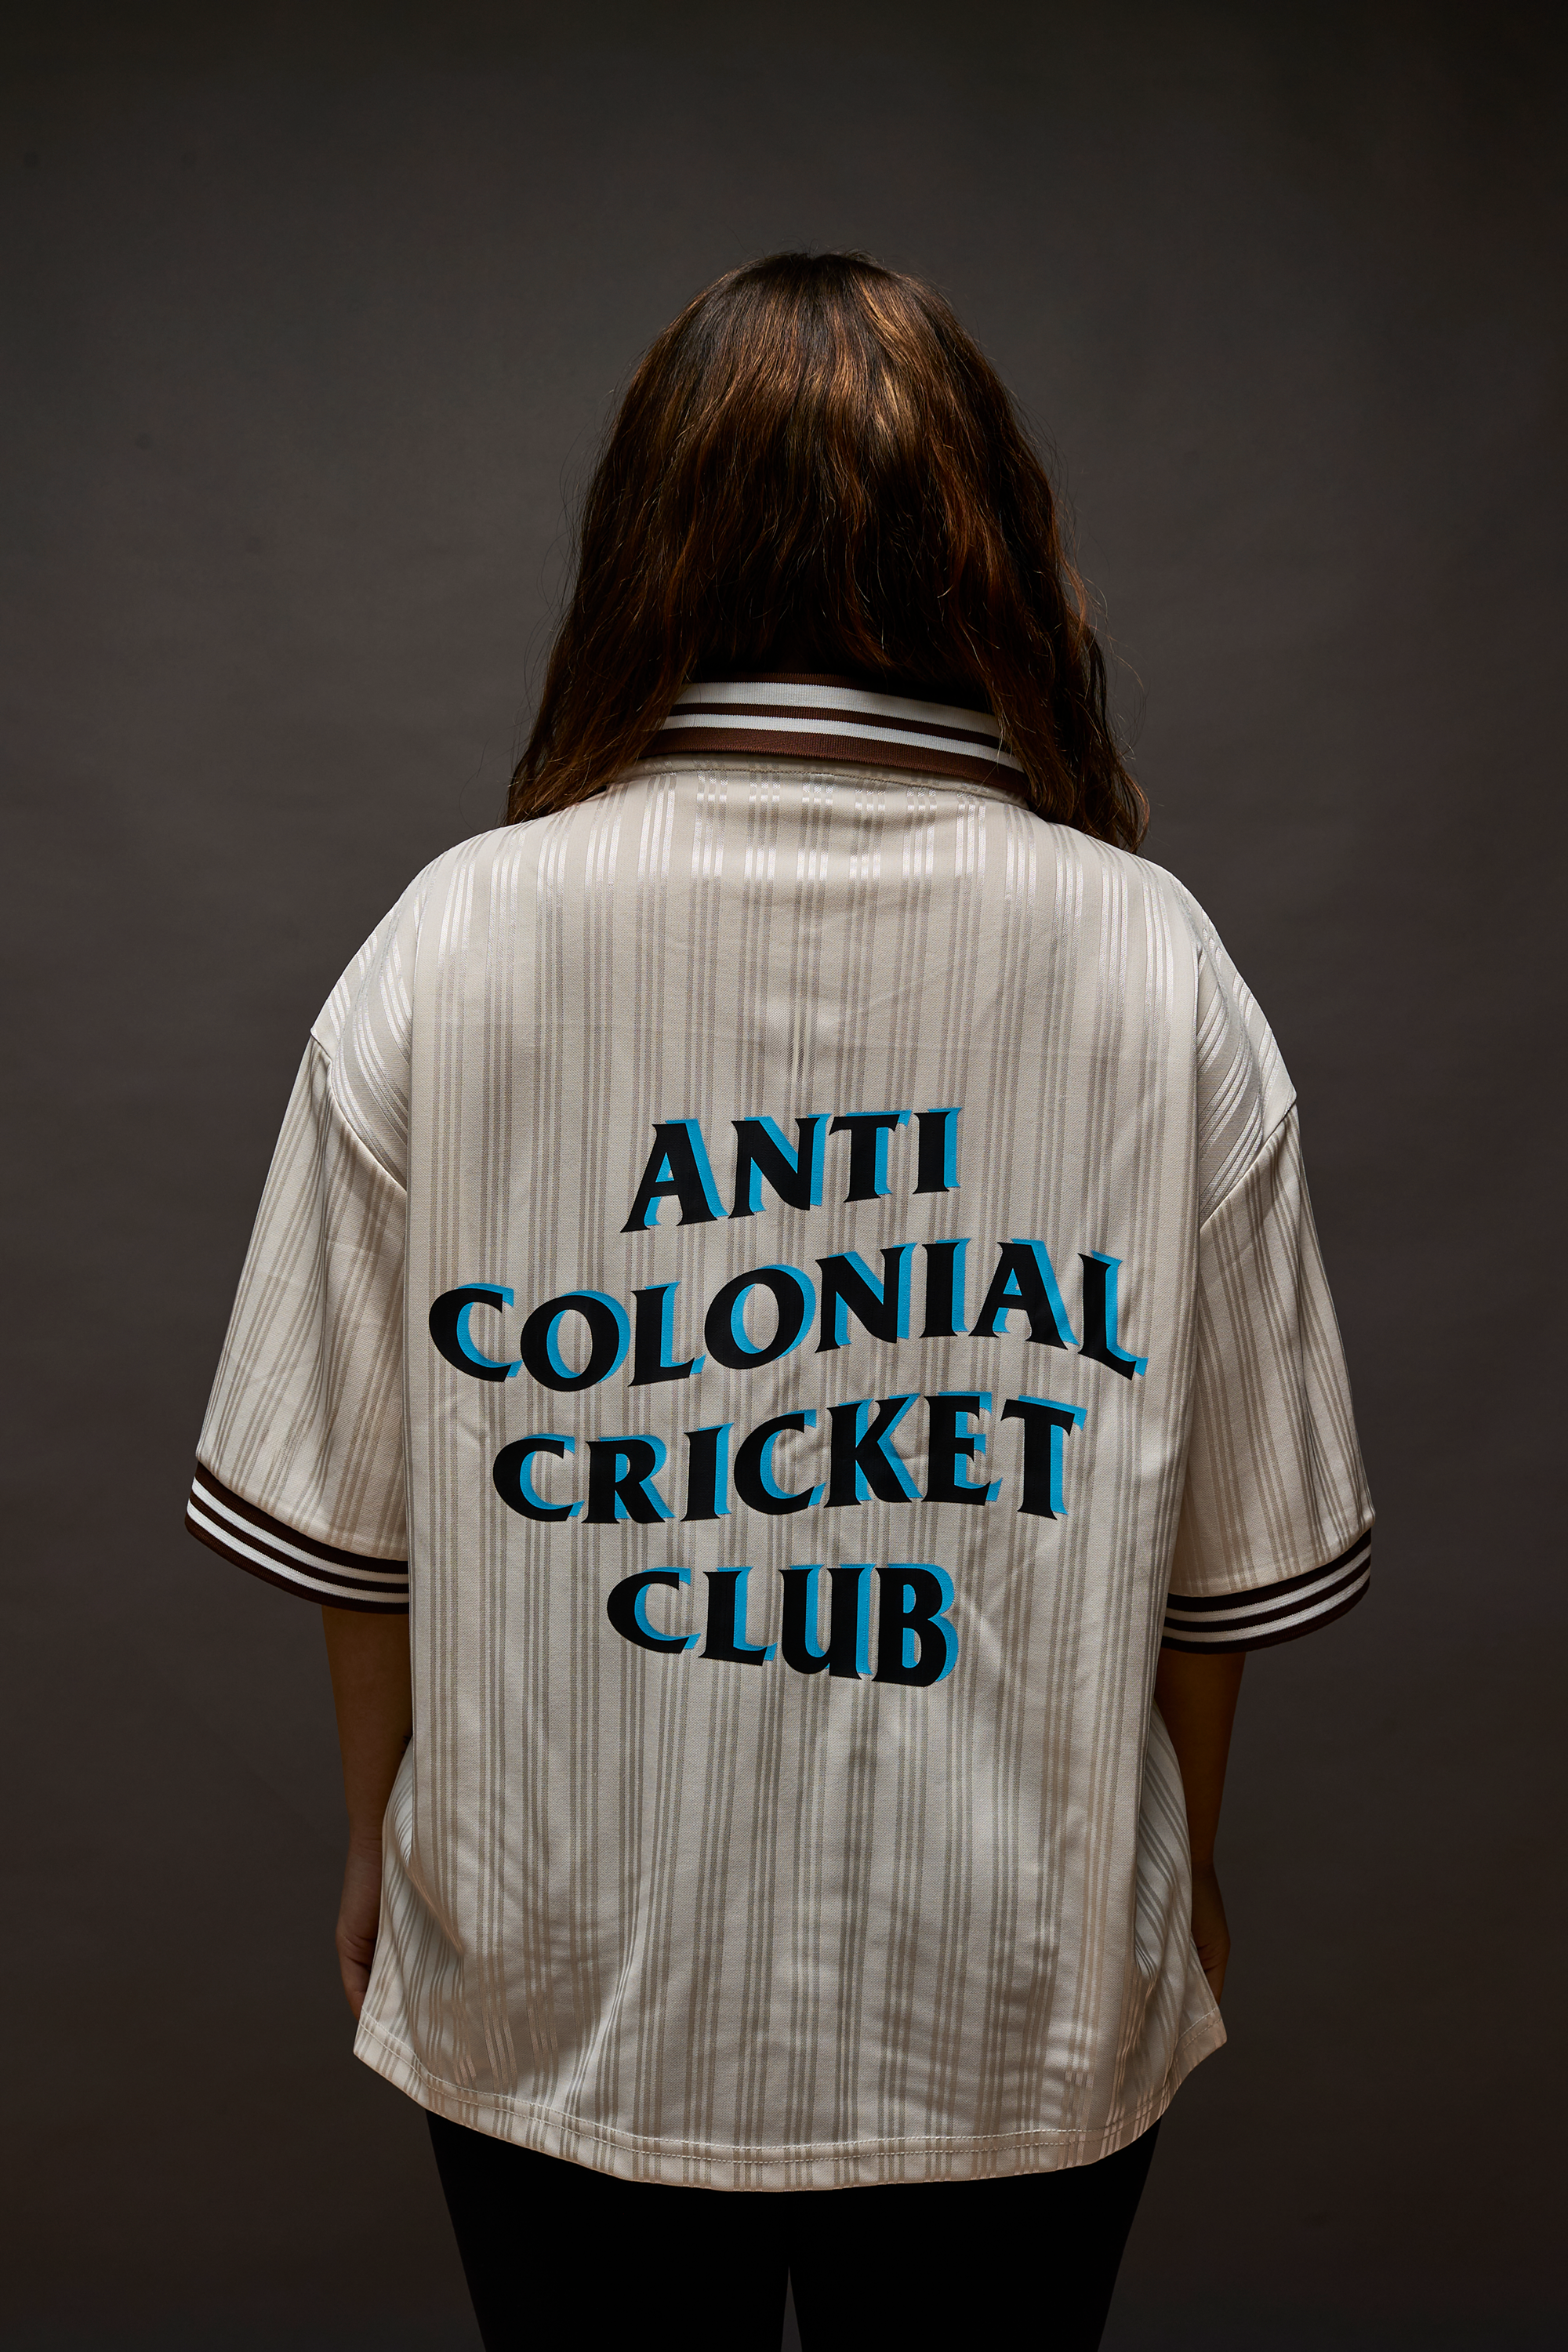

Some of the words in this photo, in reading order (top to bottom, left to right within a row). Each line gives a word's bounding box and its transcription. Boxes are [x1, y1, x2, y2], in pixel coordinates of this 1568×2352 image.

[620, 1107, 962, 1233] ANTI
[428, 1238, 1149, 1392] COLONIAL
[492, 1391, 1087, 1524] CRICKET
[606, 1563, 958, 1687] CLUB
